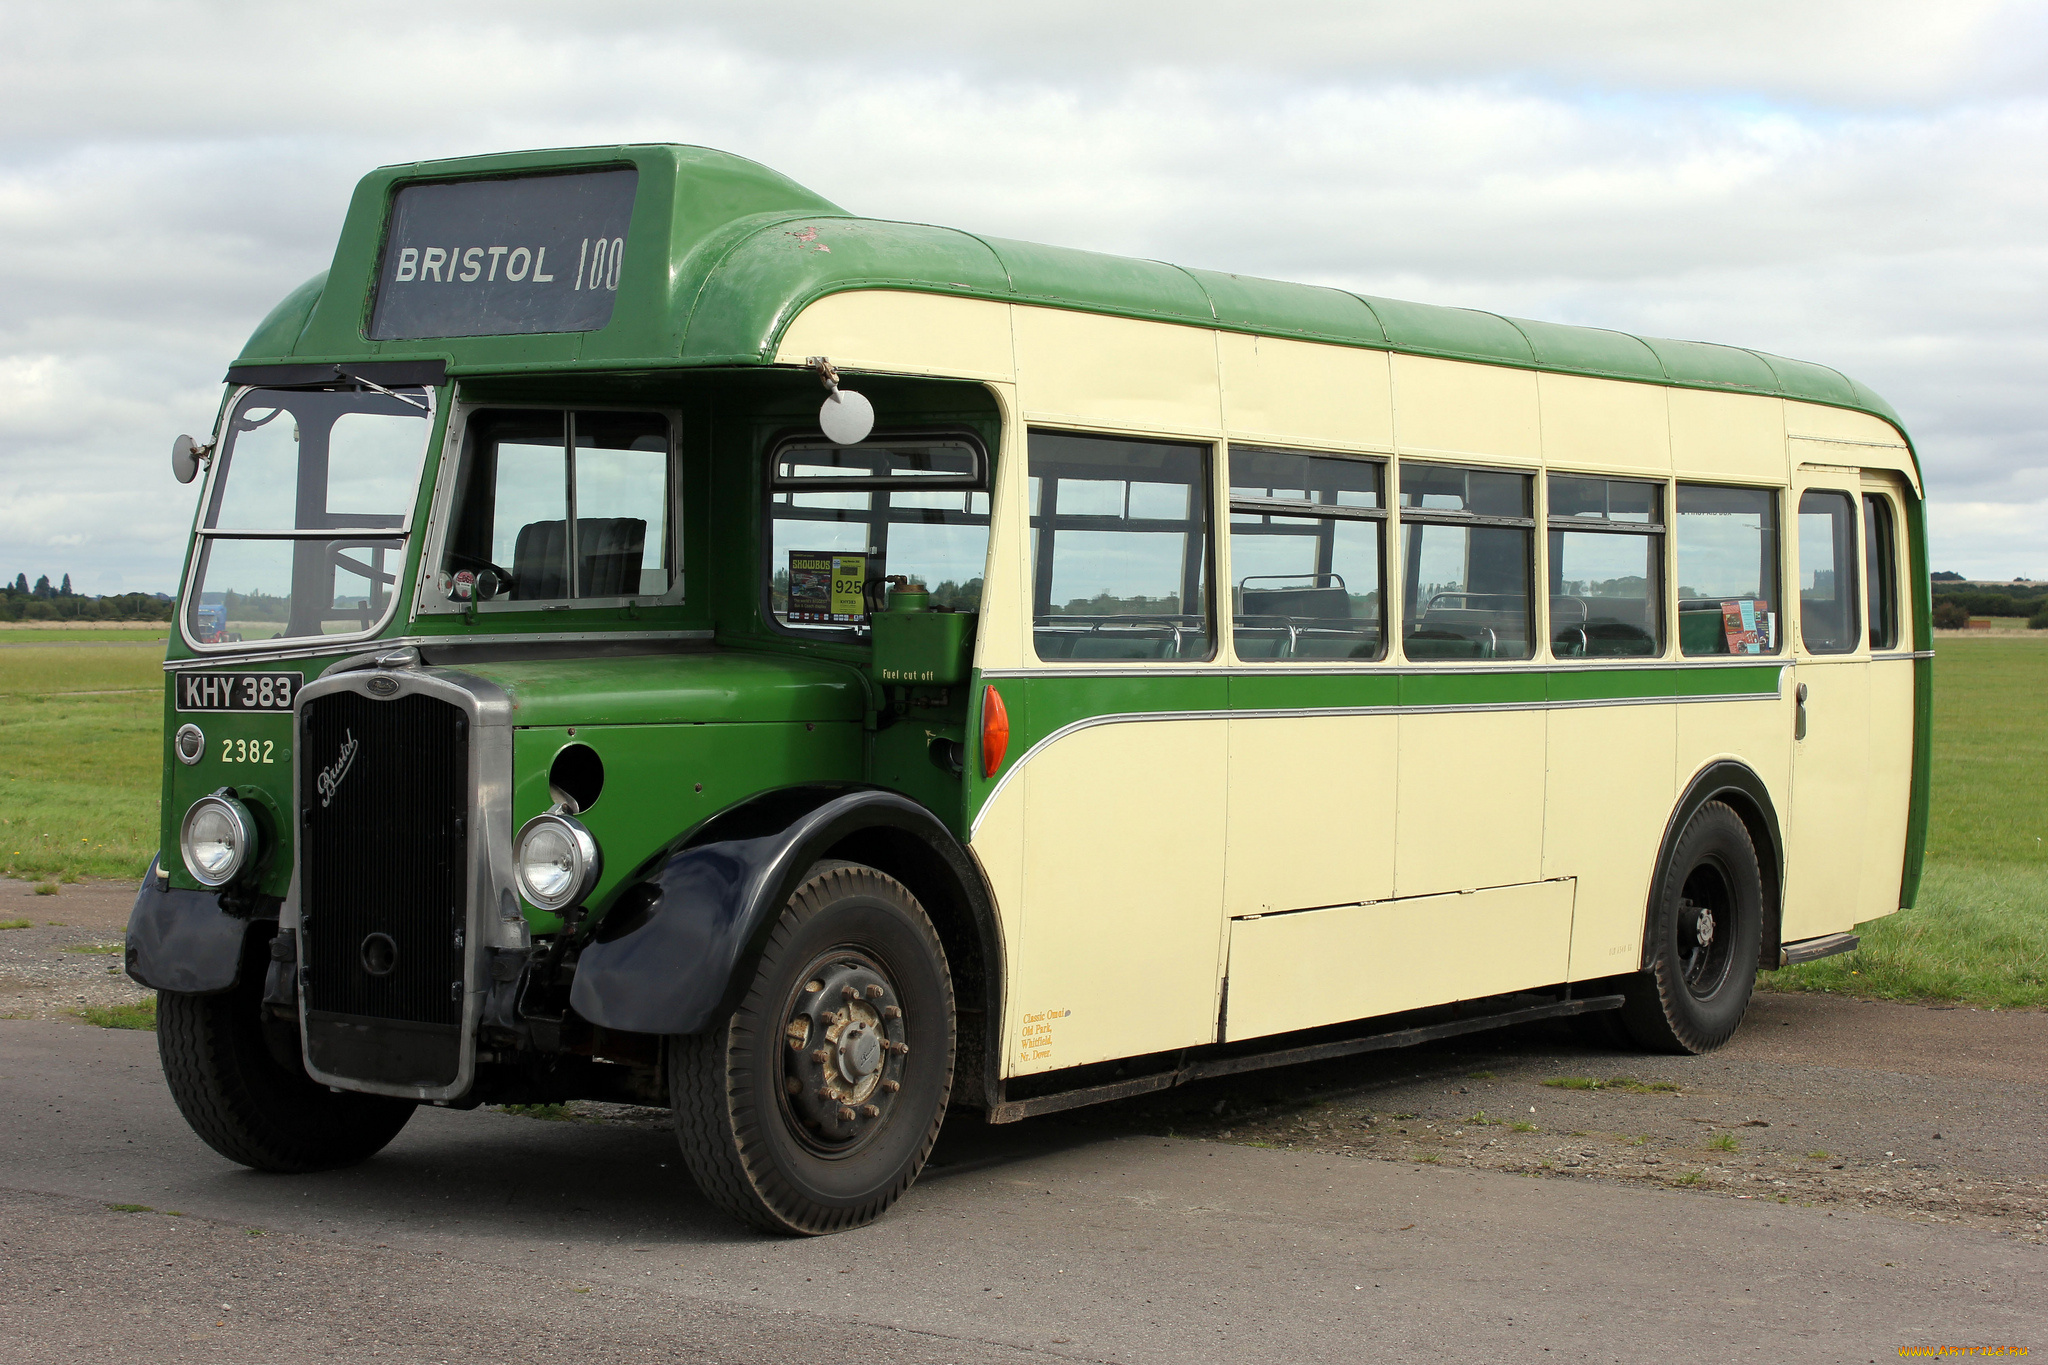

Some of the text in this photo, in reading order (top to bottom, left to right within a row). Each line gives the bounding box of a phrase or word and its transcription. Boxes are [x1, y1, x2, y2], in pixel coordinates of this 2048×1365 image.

[395, 237, 624, 291] BRISTOL 100
[792, 559, 831, 570] SHOWBUS
[835, 580, 862, 594] 925
[882, 668, 934, 681] Fuel cut off
[186, 676, 292, 707] KHY 383
[222, 738, 274, 764] 2382
[317, 727, 359, 808] Bristol
[1023, 1011, 1045, 1024] Classic
[1022, 1022, 1052, 1037] Old Park,
[1021, 1034, 1052, 1049] Whitfield,
